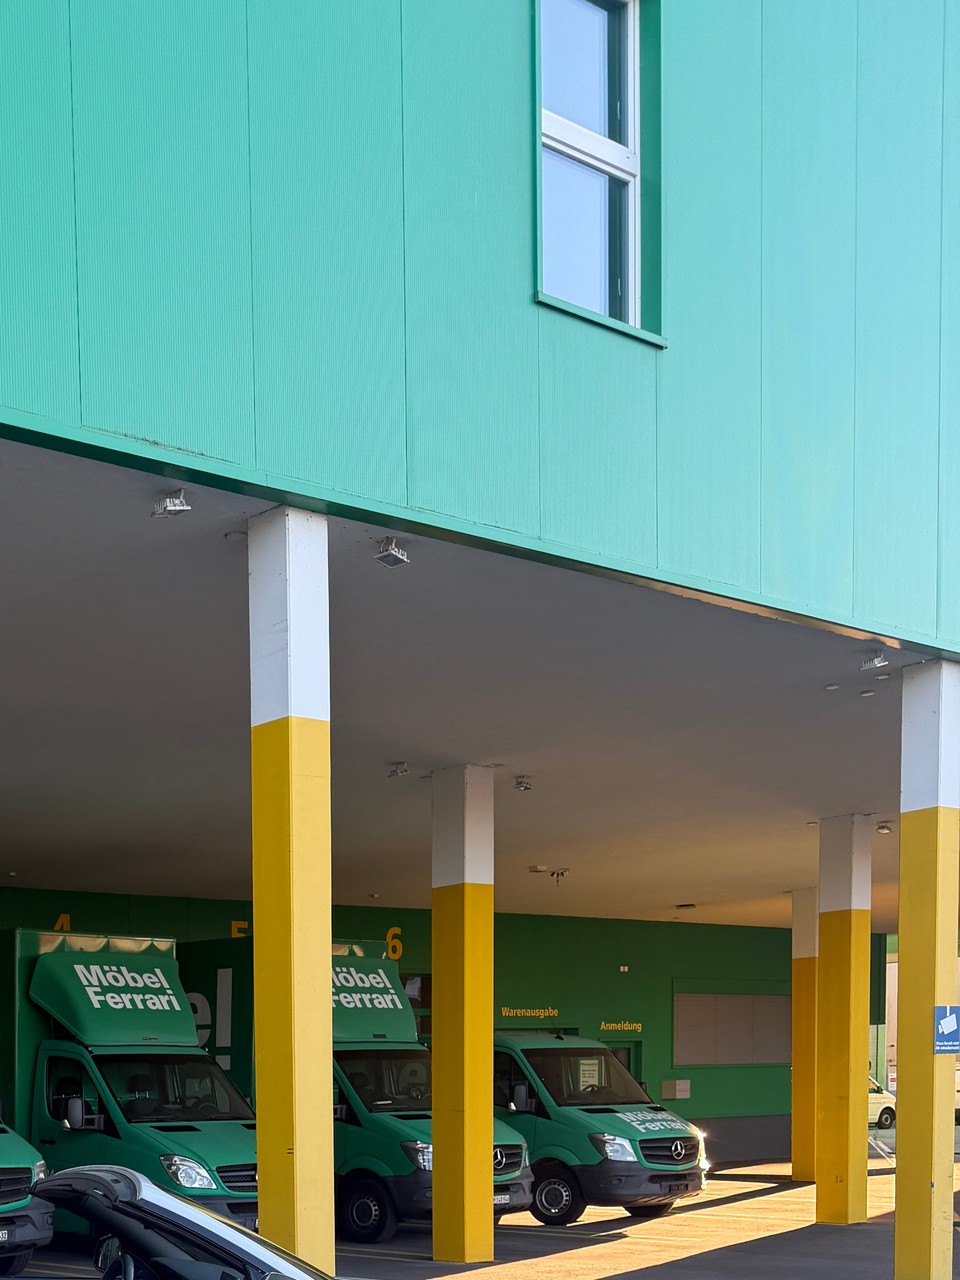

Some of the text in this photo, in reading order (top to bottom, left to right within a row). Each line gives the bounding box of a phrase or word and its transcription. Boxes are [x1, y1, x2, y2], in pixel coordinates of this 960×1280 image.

[386, 926, 403, 960] 6
[73, 964, 170, 989] Möbel
[85, 986, 182, 1011] Ferrari
[501, 1006, 559, 1019] Warenausgabe
[600, 1020, 642, 1032] Anmeldung
[630, 1119, 692, 1133] Ferrari
